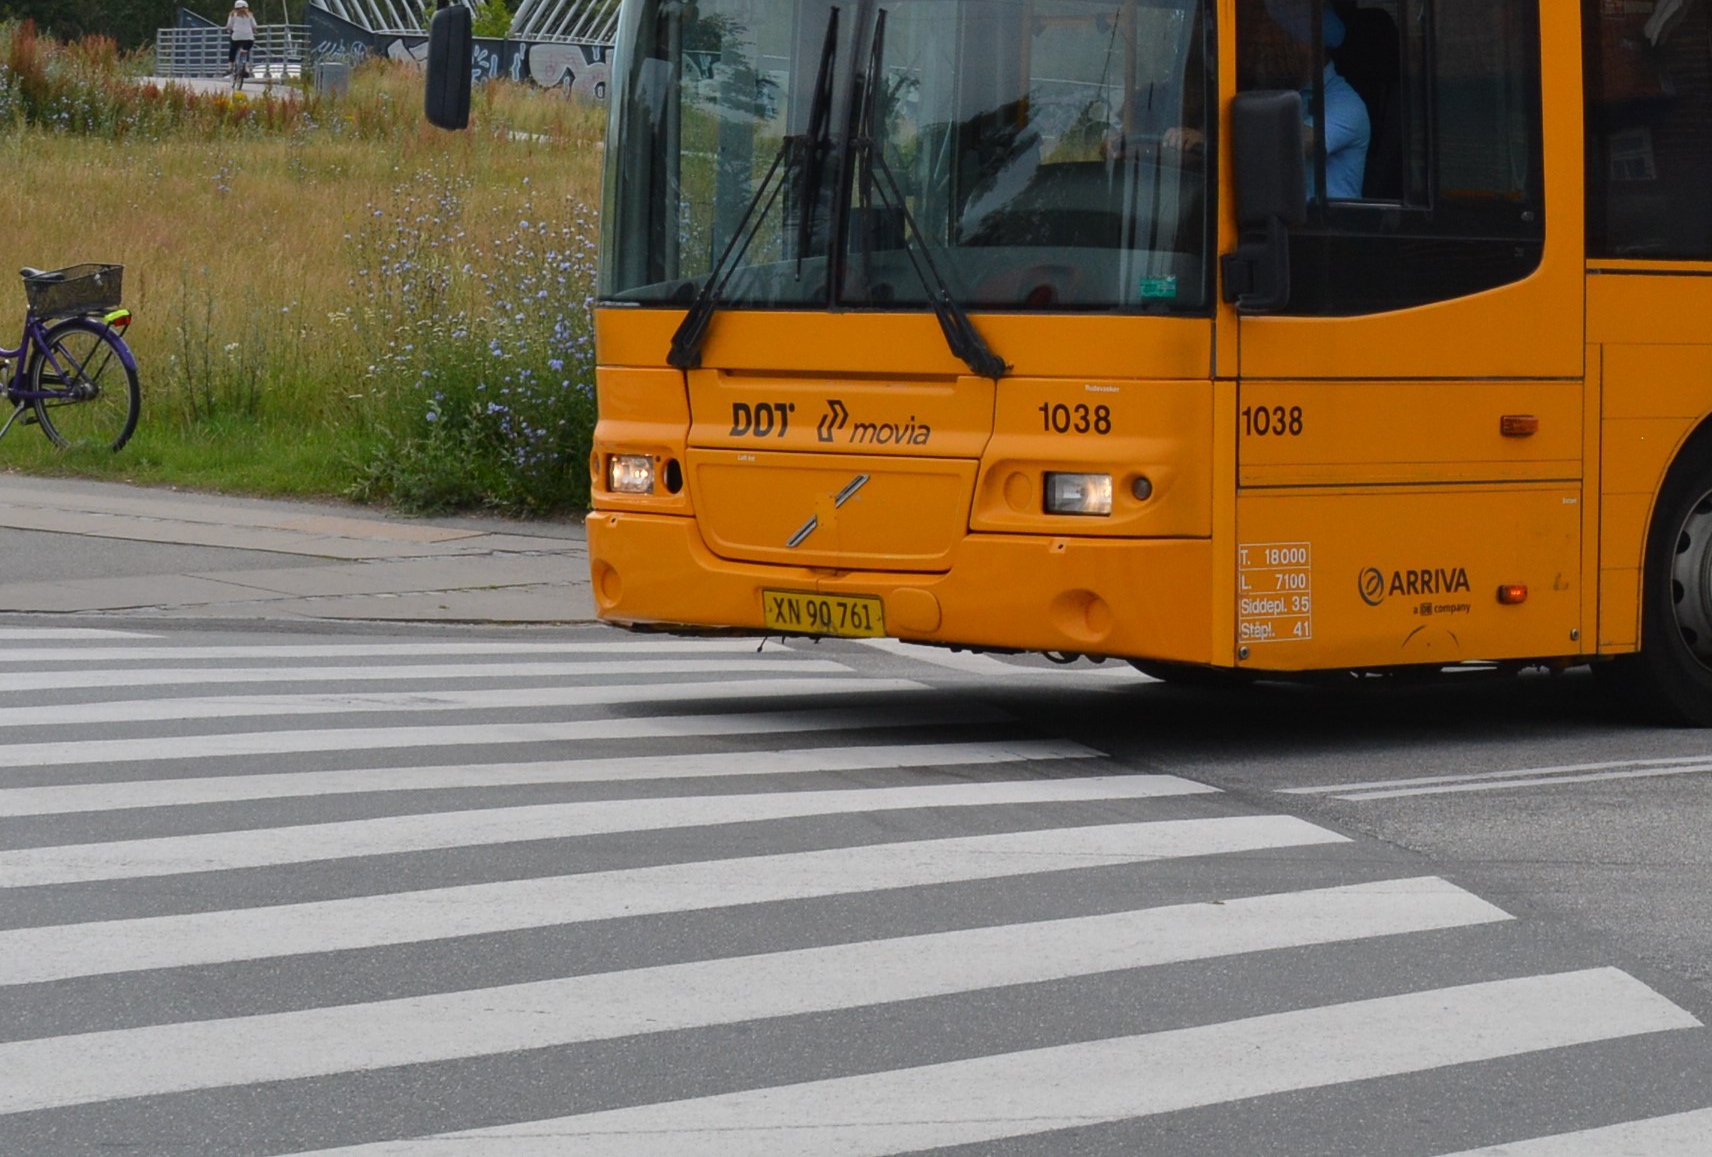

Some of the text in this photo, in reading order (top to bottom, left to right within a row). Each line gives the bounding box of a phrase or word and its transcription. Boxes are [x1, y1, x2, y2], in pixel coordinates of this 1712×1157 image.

[729, 402, 796, 437] DOT
[849, 416, 931, 445] movia
[1039, 402, 1111, 435] 1038
[1242, 406, 1303, 436] 1038
[1265, 548, 1306, 565] 18000
[1275, 573, 1306, 590] 7100
[1388, 568, 1471, 596] ARRIVA
[773, 597, 872, 630] XN 90 761
[1241, 596, 1309, 615] Siddepl. 35
[1434, 603, 1471, 615] company
[1294, 621, 1310, 637] 41
